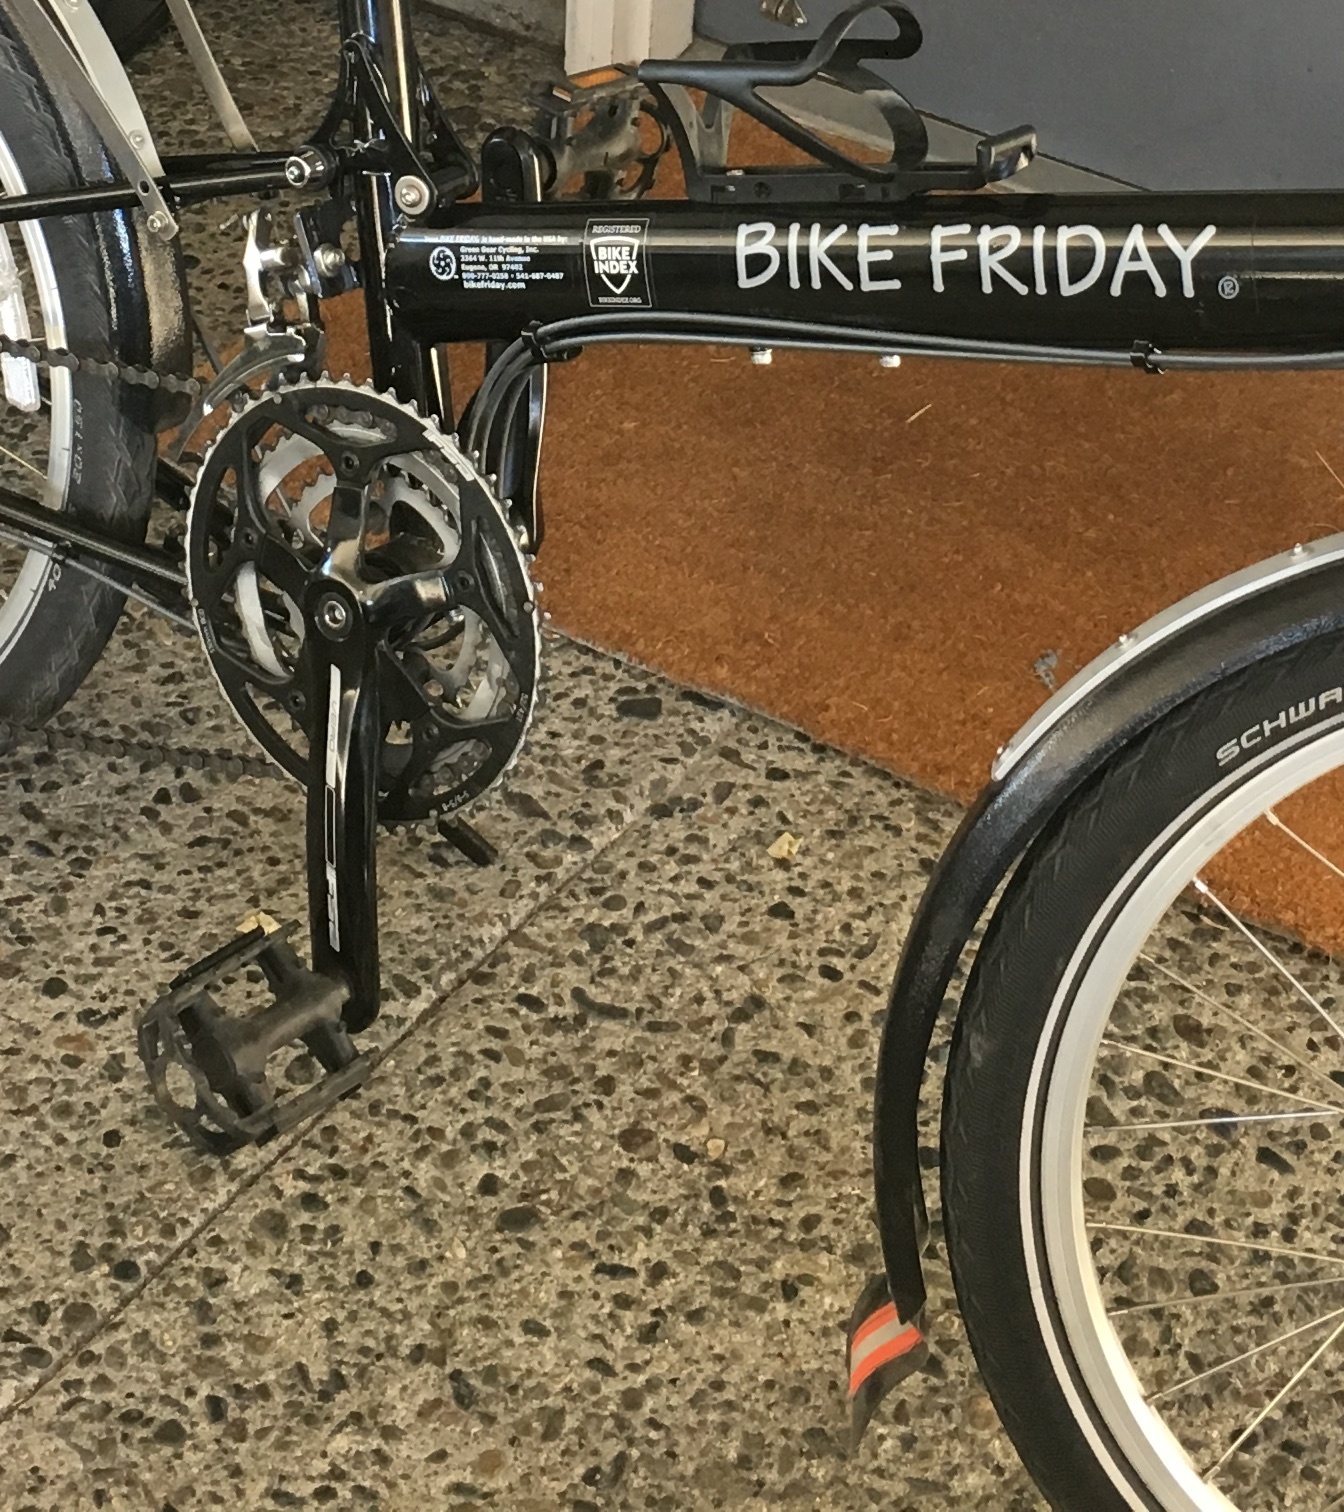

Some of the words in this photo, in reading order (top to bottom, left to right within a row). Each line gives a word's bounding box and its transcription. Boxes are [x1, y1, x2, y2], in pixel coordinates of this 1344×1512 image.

[592, 225, 641, 234] REGISTERED
[598, 246, 630, 260] BIKE
[736, 222, 901, 291] BIKE
[930, 223, 1217, 298] FRIDAY
[594, 260, 639, 274] INDEX
[463, 281, 526, 290] bikefriday.com
